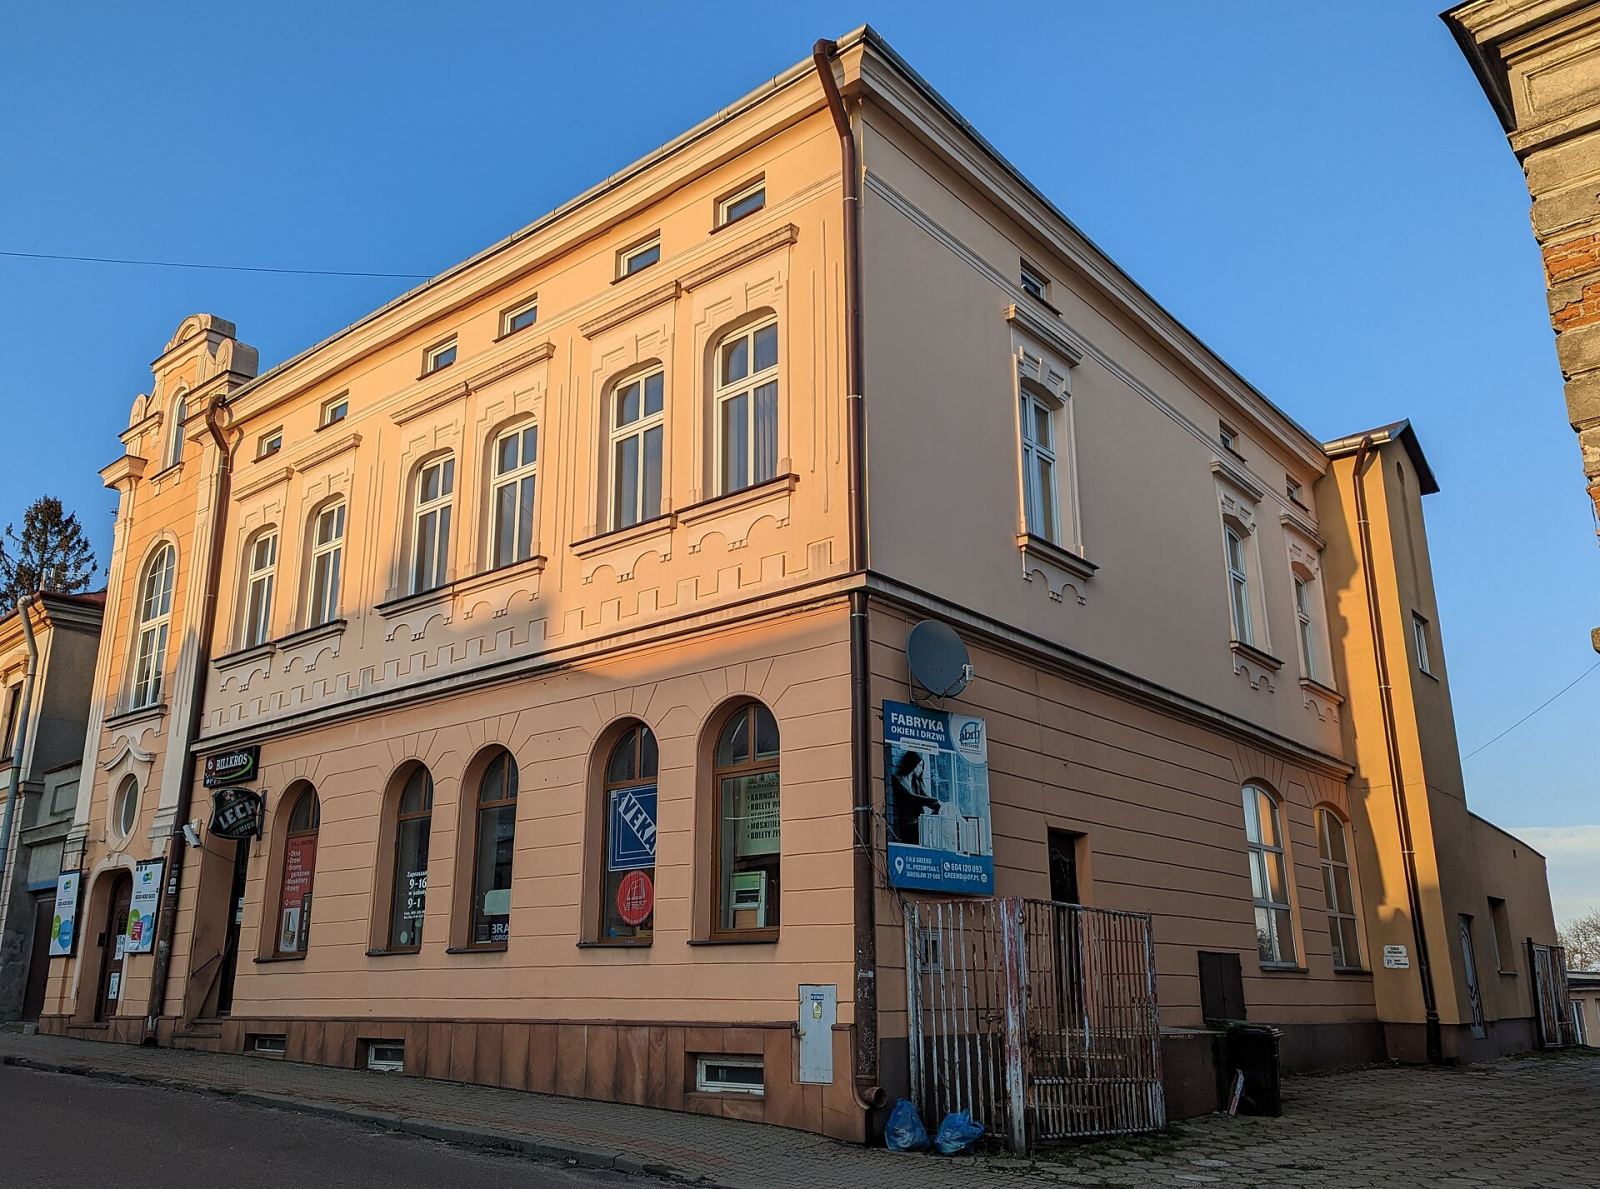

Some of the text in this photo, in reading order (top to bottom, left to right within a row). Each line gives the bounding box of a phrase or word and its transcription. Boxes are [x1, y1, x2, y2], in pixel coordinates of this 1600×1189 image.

[890, 712, 945, 733] FABRYKA
[890, 725, 916, 738] OKIEN
[921, 731, 945, 742] DRZWI
[216, 753, 249, 771] BILLKROS
[218, 799, 256, 831] LECH
[621, 795, 657, 853] VEKA
[962, 864, 972, 873] 120
[409, 877, 427, 890] 9-16
